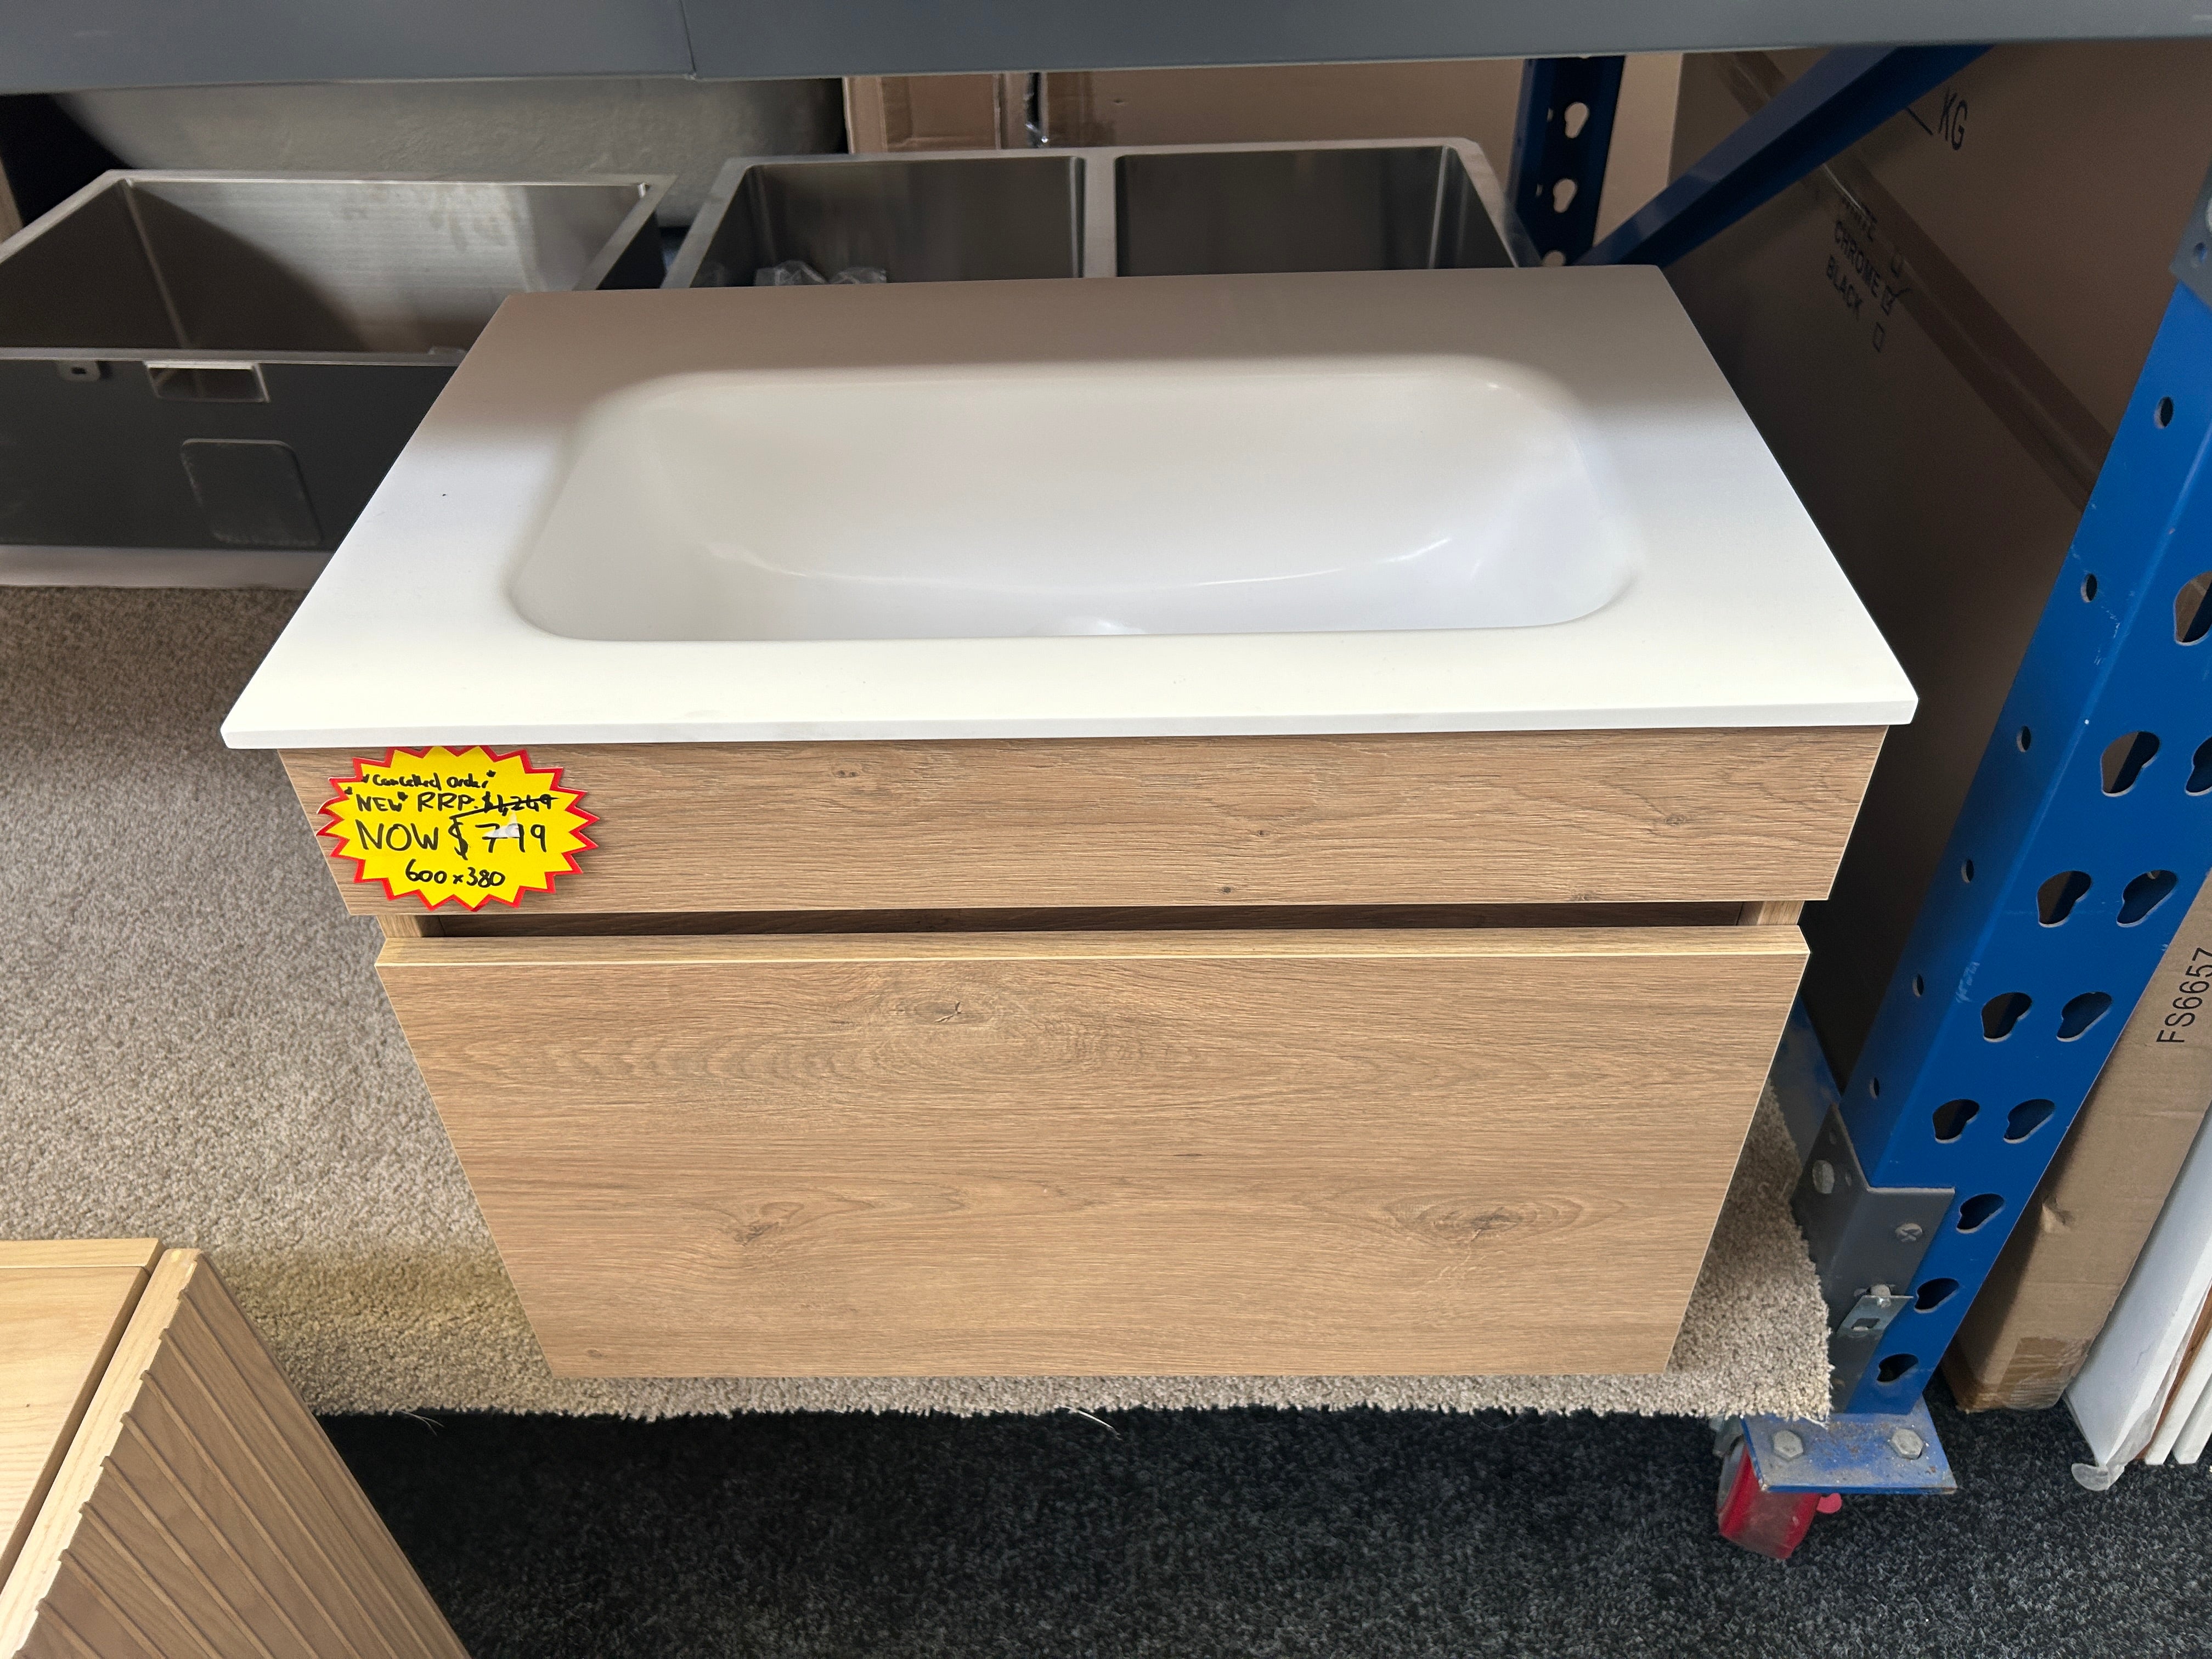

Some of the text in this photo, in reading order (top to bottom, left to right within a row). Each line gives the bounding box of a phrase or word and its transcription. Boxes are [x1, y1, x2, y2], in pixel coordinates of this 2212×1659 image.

[1937, 87, 1968, 150] KG
[1826, 255, 1863, 320] BLACK
[1833, 221, 1881, 298] CHROME
[355, 819, 439, 851] NOW
[2155, 947, 2212, 1043] FS6657
